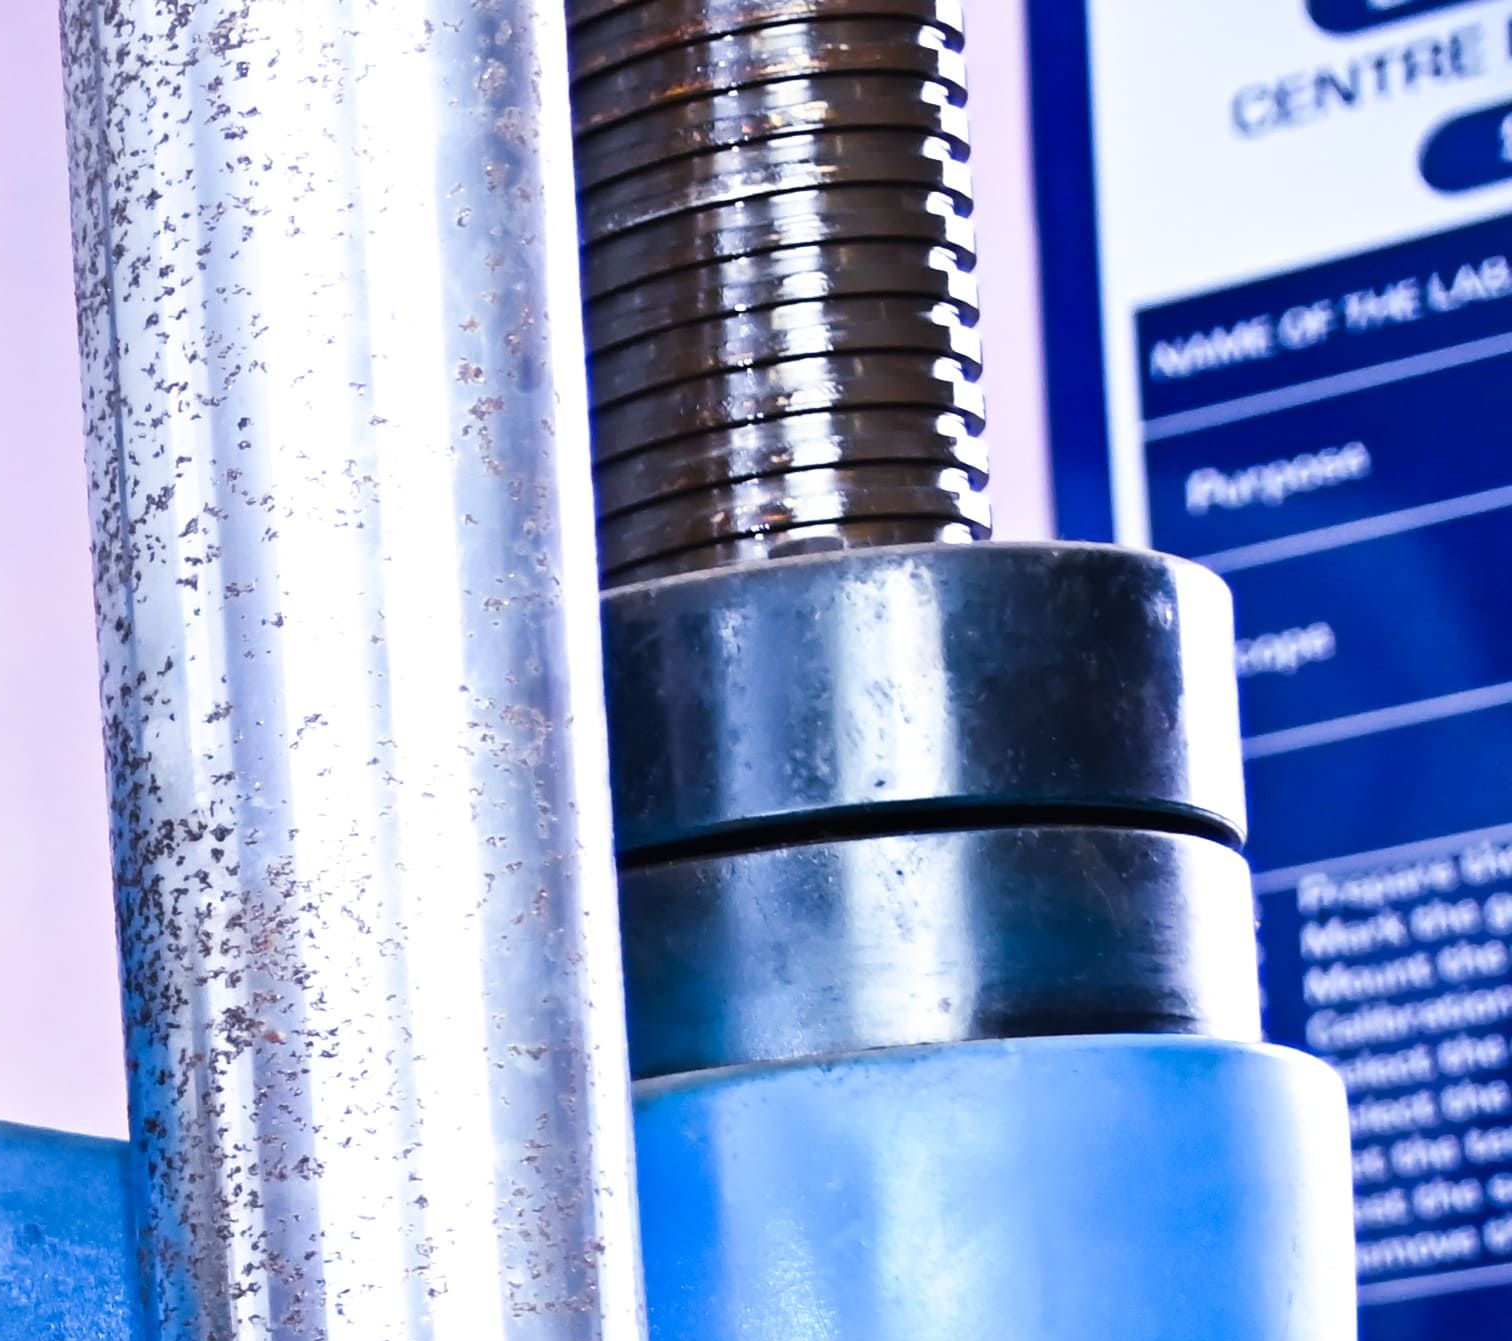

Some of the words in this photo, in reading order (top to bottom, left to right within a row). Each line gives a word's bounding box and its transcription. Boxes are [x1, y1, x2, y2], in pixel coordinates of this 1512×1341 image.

[1231, 28, 1485, 137] CENTRE
[1151, 315, 1275, 379] NAME
[1278, 298, 1337, 349] OF
[1344, 276, 1421, 334] THE
[1186, 441, 1371, 513] Purpose
[1235, 622, 1337, 676] cope
[1298, 857, 1459, 914] Prepare
[1301, 908, 1408, 959] Mark
[1410, 897, 1482, 941] the
[1304, 953, 1435, 1004] Mount
[1437, 940, 1509, 982] the
[1332, 1042, 1436, 1090] elect
[1437, 1034, 1508, 1076] the
[1441, 1080, 1512, 1122] the
[1391, 1135, 1461, 1177] the
[1412, 1177, 1484, 1220] the
[1355, 1224, 1482, 1272] emove
